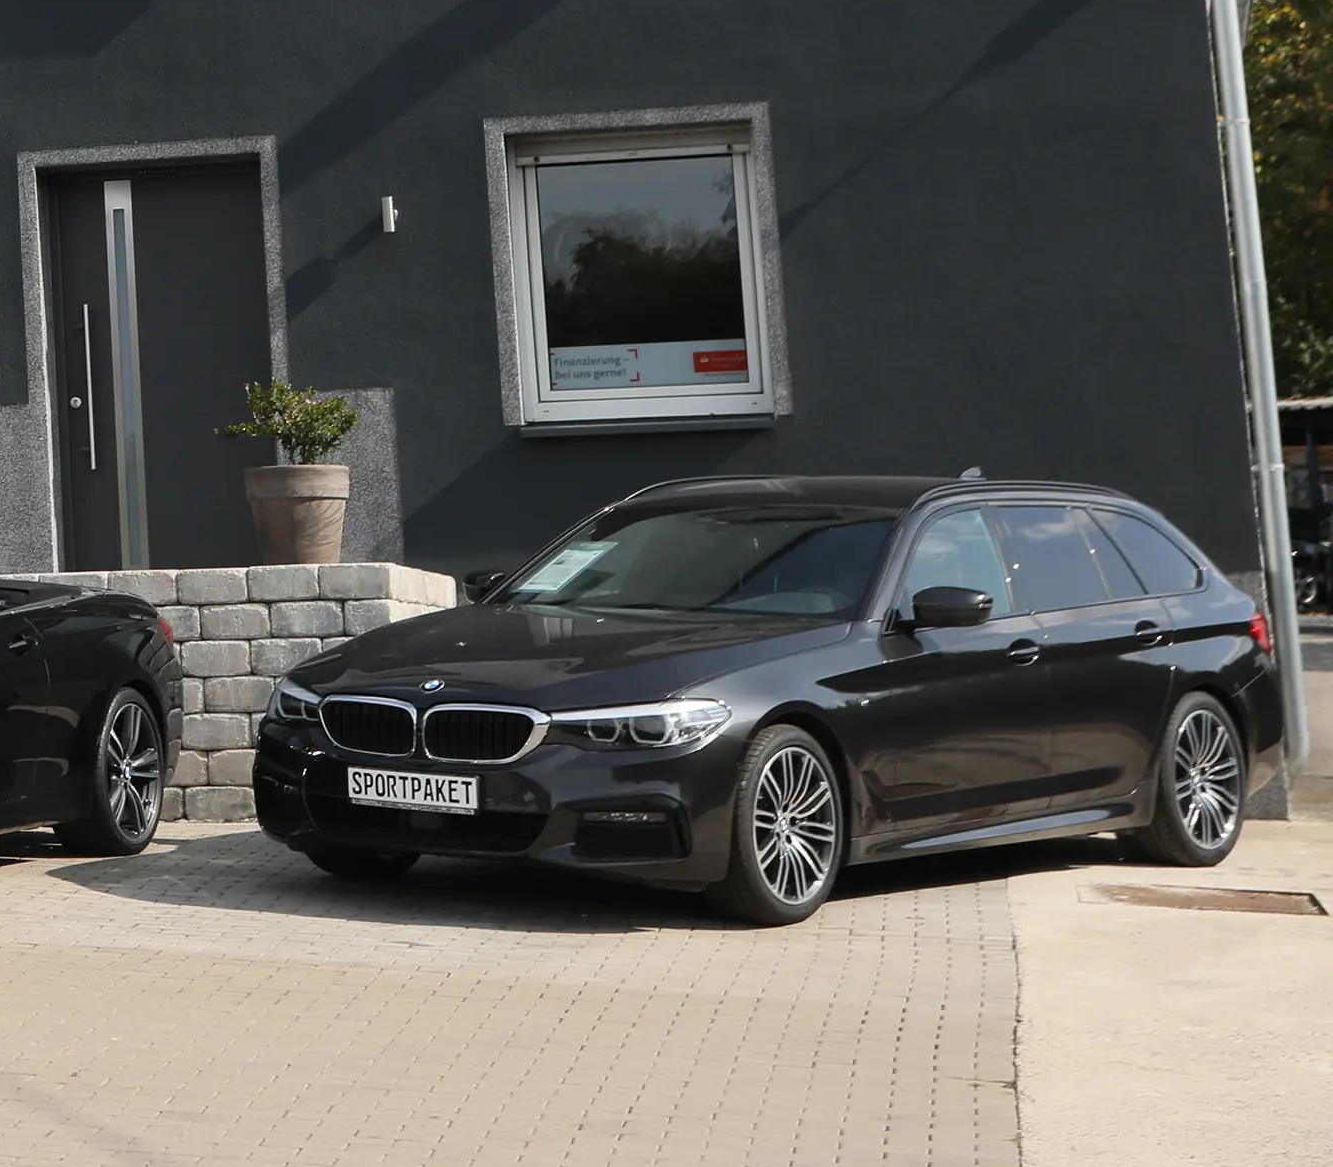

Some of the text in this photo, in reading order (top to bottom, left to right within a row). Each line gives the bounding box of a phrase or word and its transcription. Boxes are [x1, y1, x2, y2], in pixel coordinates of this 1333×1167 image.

[554, 356, 621, 367] Finanzierung
[555, 368, 627, 381] bei uns gerne!
[352, 771, 472, 804] SPORTPAKET
